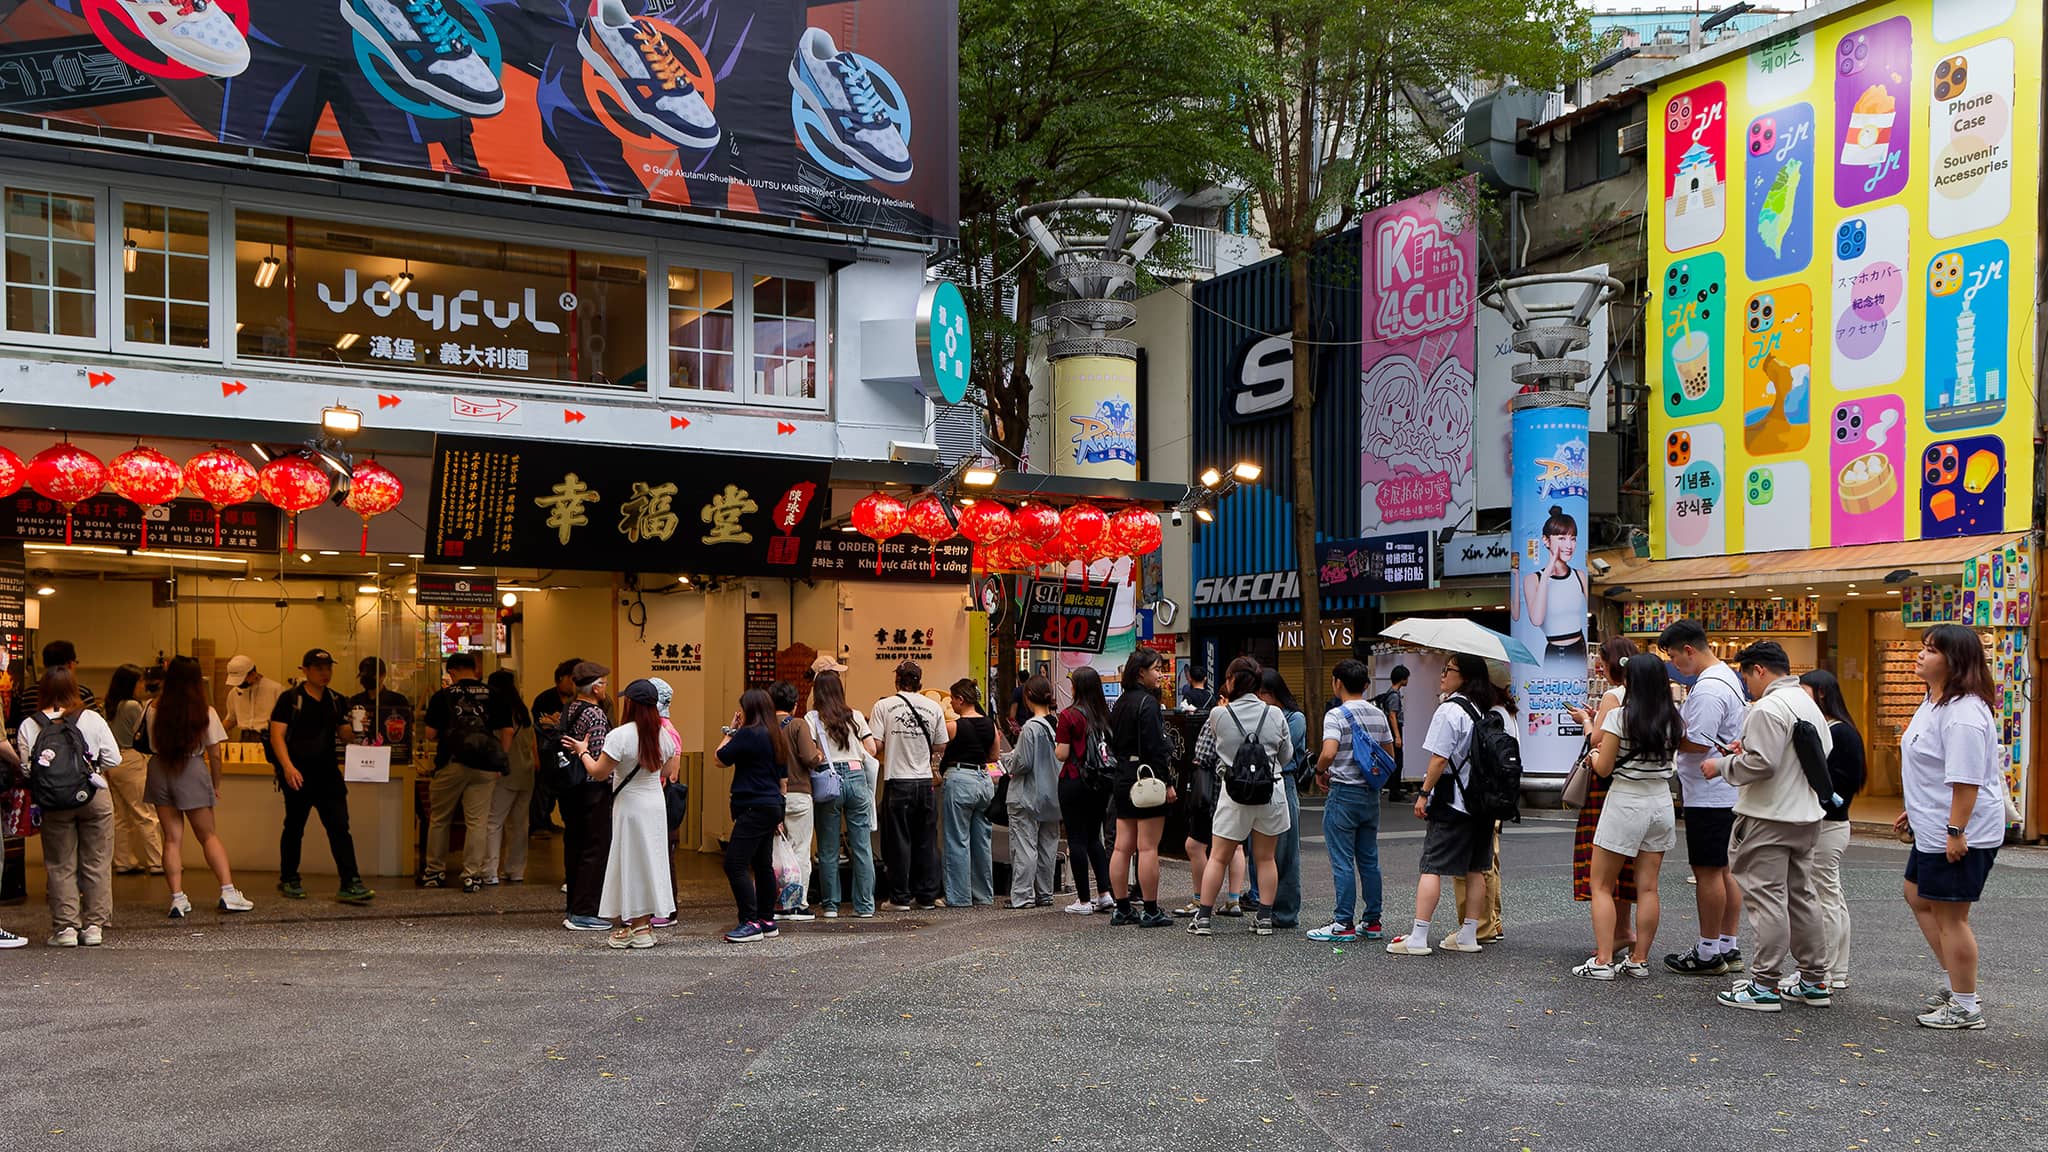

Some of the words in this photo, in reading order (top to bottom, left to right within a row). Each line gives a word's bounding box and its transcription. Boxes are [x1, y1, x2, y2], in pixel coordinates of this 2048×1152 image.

[1761, 50, 1804, 74] 케이스.
[1948, 94, 1993, 115] Phone
[1954, 115, 1986, 132] Case
[1943, 144, 1999, 169] Souvenir
[1934, 159, 2008, 187] Accessories
[652, 165, 675, 178] Gege
[746, 180, 780, 192] JUJUTSU
[781, 183, 810, 195] KAISEN
[839, 191, 871, 204] Licensed
[872, 194, 881, 206] by
[1838, 267, 1903, 289] スマホカバー
[1382, 278, 1463, 330] 4Cut
[1852, 293, 1885, 310] 紀念物
[1836, 318, 1901, 340] アクセサリー
[460, 404, 485, 414] 2F
[1674, 470, 1715, 491] 기념품.
[534, 472, 758, 546] 幸福堂
[1676, 498, 1714, 518] 장식품
[16, 517, 79, 527] HAND-FRID
[85, 520, 112, 529] BOBA
[117, 523, 165, 531] CHEC-IN
[170, 525, 190, 533] AND
[195, 527, 228, 535] PHOO
[233, 529, 257, 537] ZONE
[16, 526, 137, 541] 手作りタピカ写真スポット
[838, 541, 875, 553] ORDER
[858, 559, 878, 569] Khu
[874, 628, 924, 645] 幸福堂
[1042, 615, 1089, 645] 80
[1087, 637, 1096, 645] 元
[651, 643, 693, 659] 幸福堂
